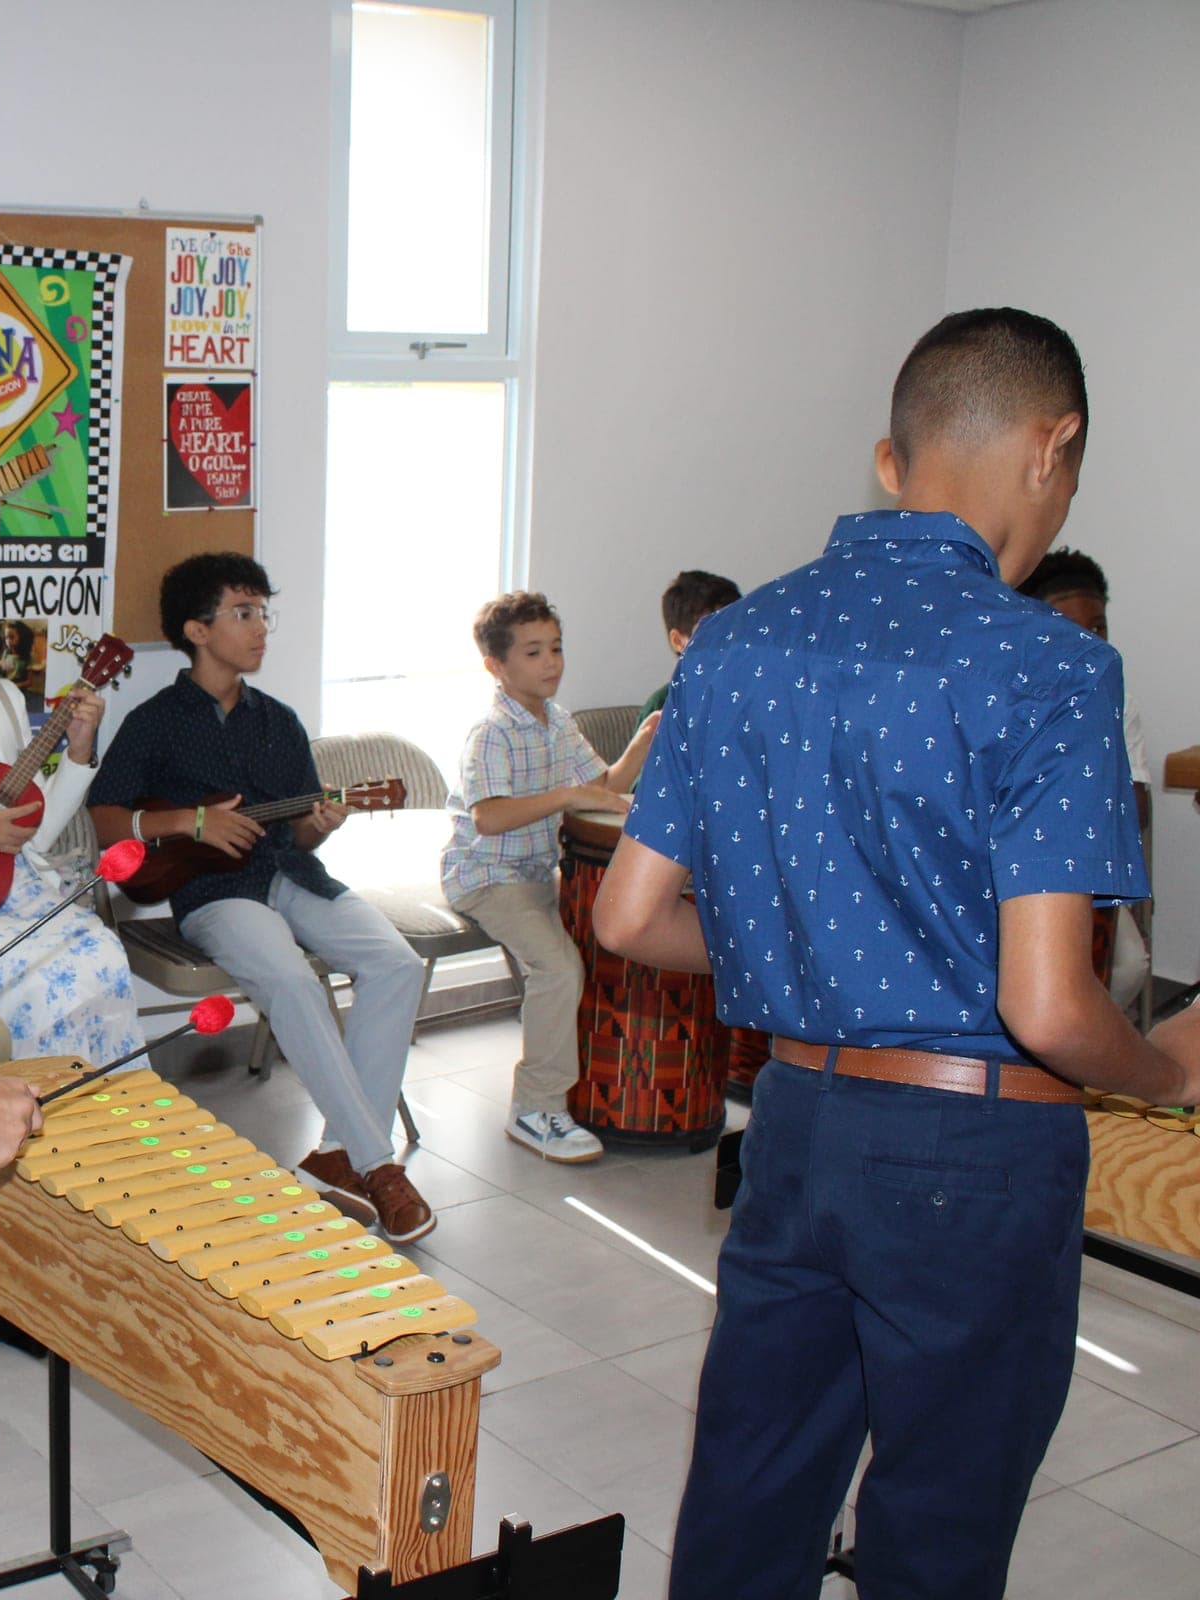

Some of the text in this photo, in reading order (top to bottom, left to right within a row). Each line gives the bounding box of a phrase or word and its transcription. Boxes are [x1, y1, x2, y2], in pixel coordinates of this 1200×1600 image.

[213, 257, 251, 288] JOY,
[170, 287, 251, 320] JOY, JOY,
[169, 335, 250, 364] HEART
[195, 403, 213, 416] ME
[179, 417, 222, 431] A PURE
[180, 432, 247, 454] HEART,
[188, 455, 199, 472] O
[58, 543, 87, 562] en
